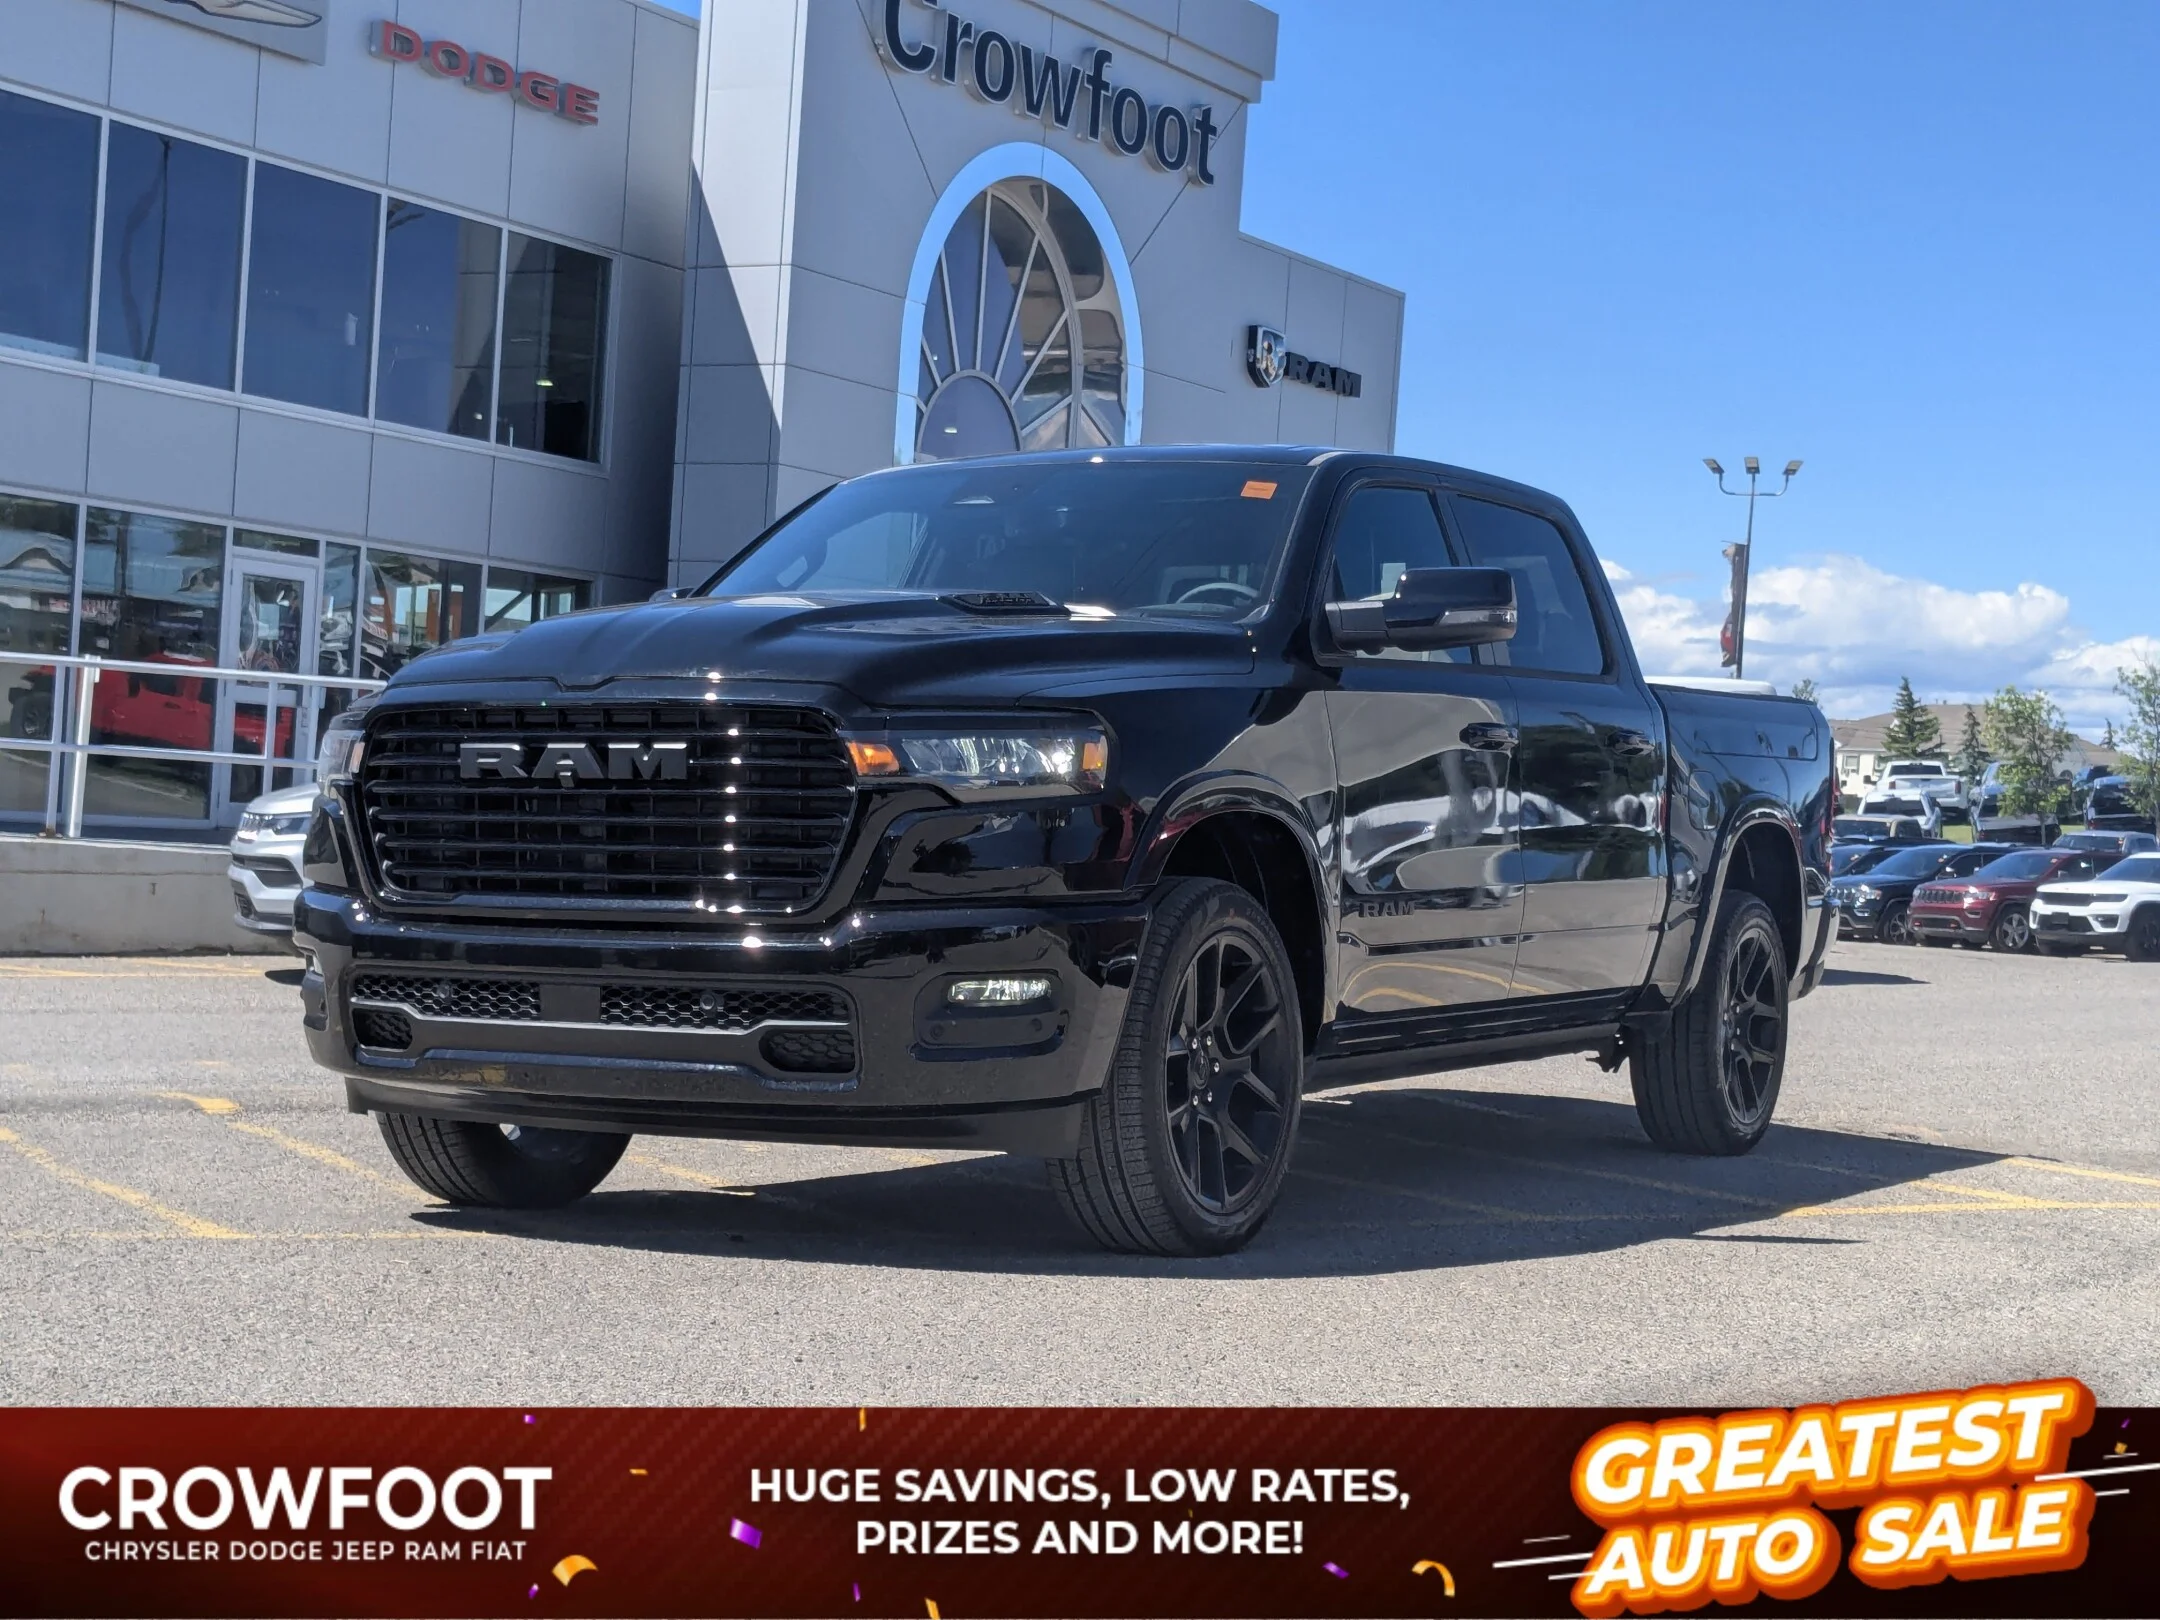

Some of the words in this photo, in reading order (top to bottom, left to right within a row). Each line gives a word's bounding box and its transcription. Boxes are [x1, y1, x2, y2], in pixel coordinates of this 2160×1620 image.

[372, 20, 600, 126] DODGE
[882, 0, 1217, 186] Crowfoot
[1285, 352, 1361, 398] RAM
[458, 742, 688, 782] RAM
[1359, 900, 1415, 918] RAM
